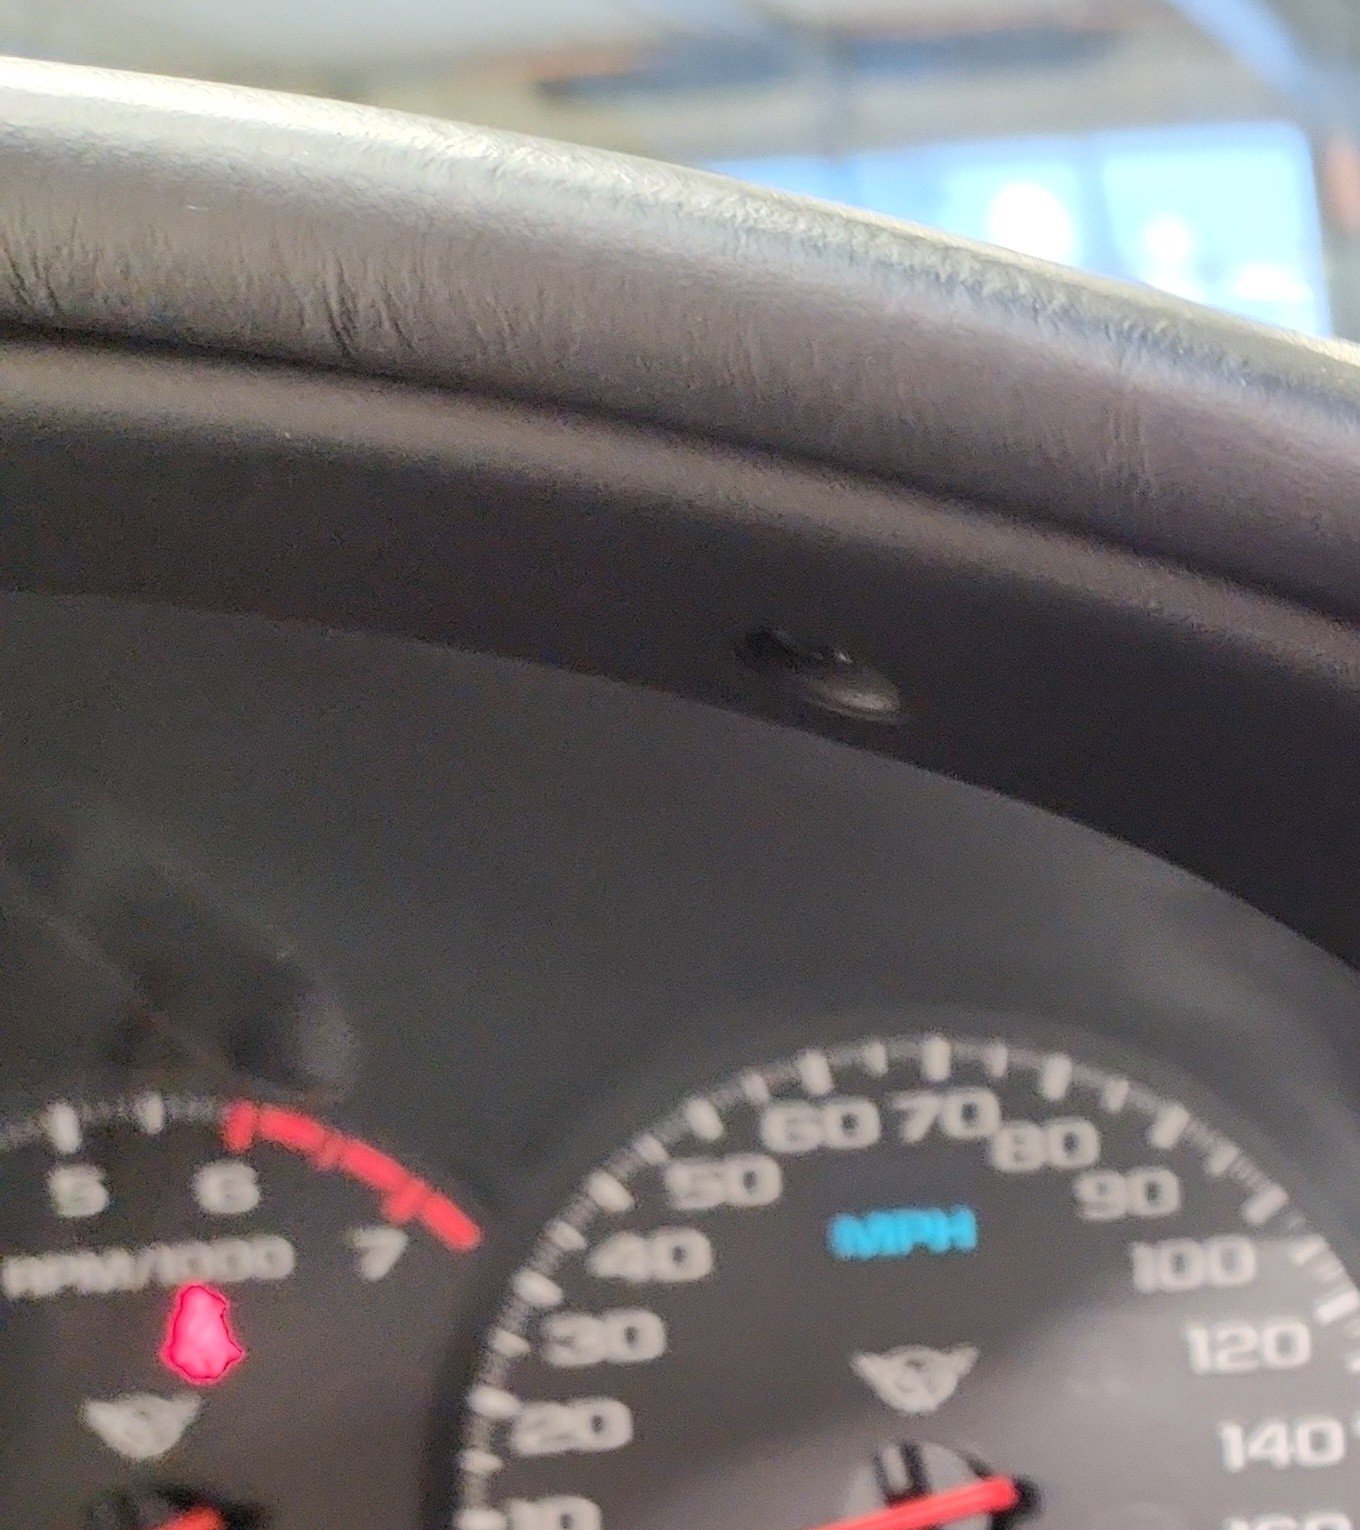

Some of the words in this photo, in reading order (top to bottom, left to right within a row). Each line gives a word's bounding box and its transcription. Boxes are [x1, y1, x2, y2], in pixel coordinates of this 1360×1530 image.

[760, 1097, 881, 1155] 60
[893, 1086, 1000, 1142] 70
[990, 1119, 1101, 1173] 80
[664, 1152, 783, 1211] 50
[1074, 1166, 1182, 1222] 90
[352, 1225, 410, 1282] 7
[590, 1227, 714, 1284] 40
[830, 1206, 978, 1259] MPH
[1132, 1234, 1258, 1292] 100
[545, 1308, 667, 1368] 30
[1187, 1315, 1313, 1373] 120
[511, 1396, 634, 1457] 20
[1219, 1415, 1347, 1471] 140
